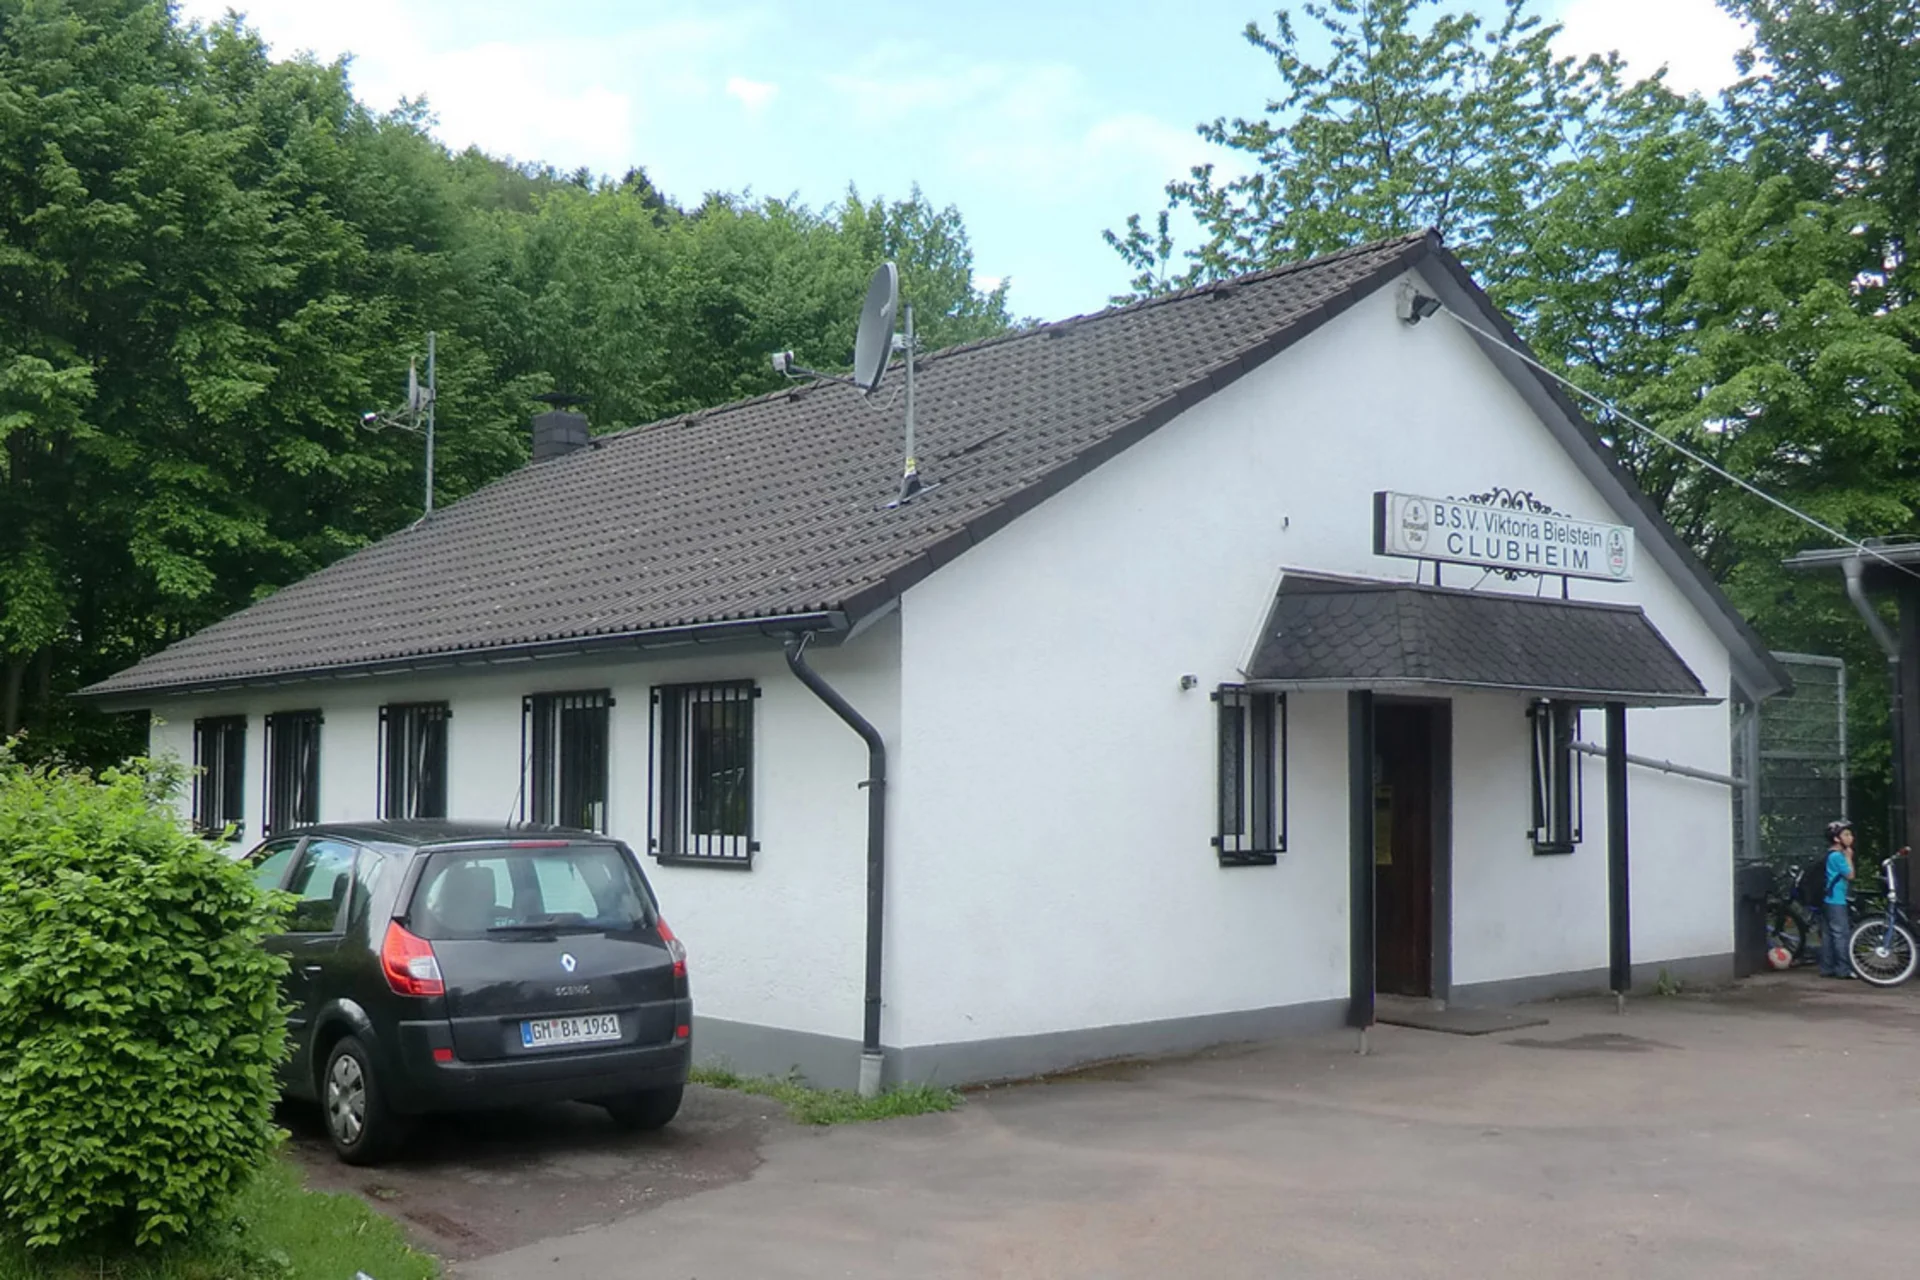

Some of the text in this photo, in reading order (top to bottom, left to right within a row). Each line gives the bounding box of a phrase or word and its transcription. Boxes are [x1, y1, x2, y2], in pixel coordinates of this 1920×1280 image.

[1434, 504, 1479, 530] B.S.V.
[1484, 513, 1539, 540] Viktoria
[1543, 520, 1601, 547] Bielstein
[1447, 532, 1588, 569] CLUBHEIM
[532, 1016, 617, 1040] GM BA 1961
